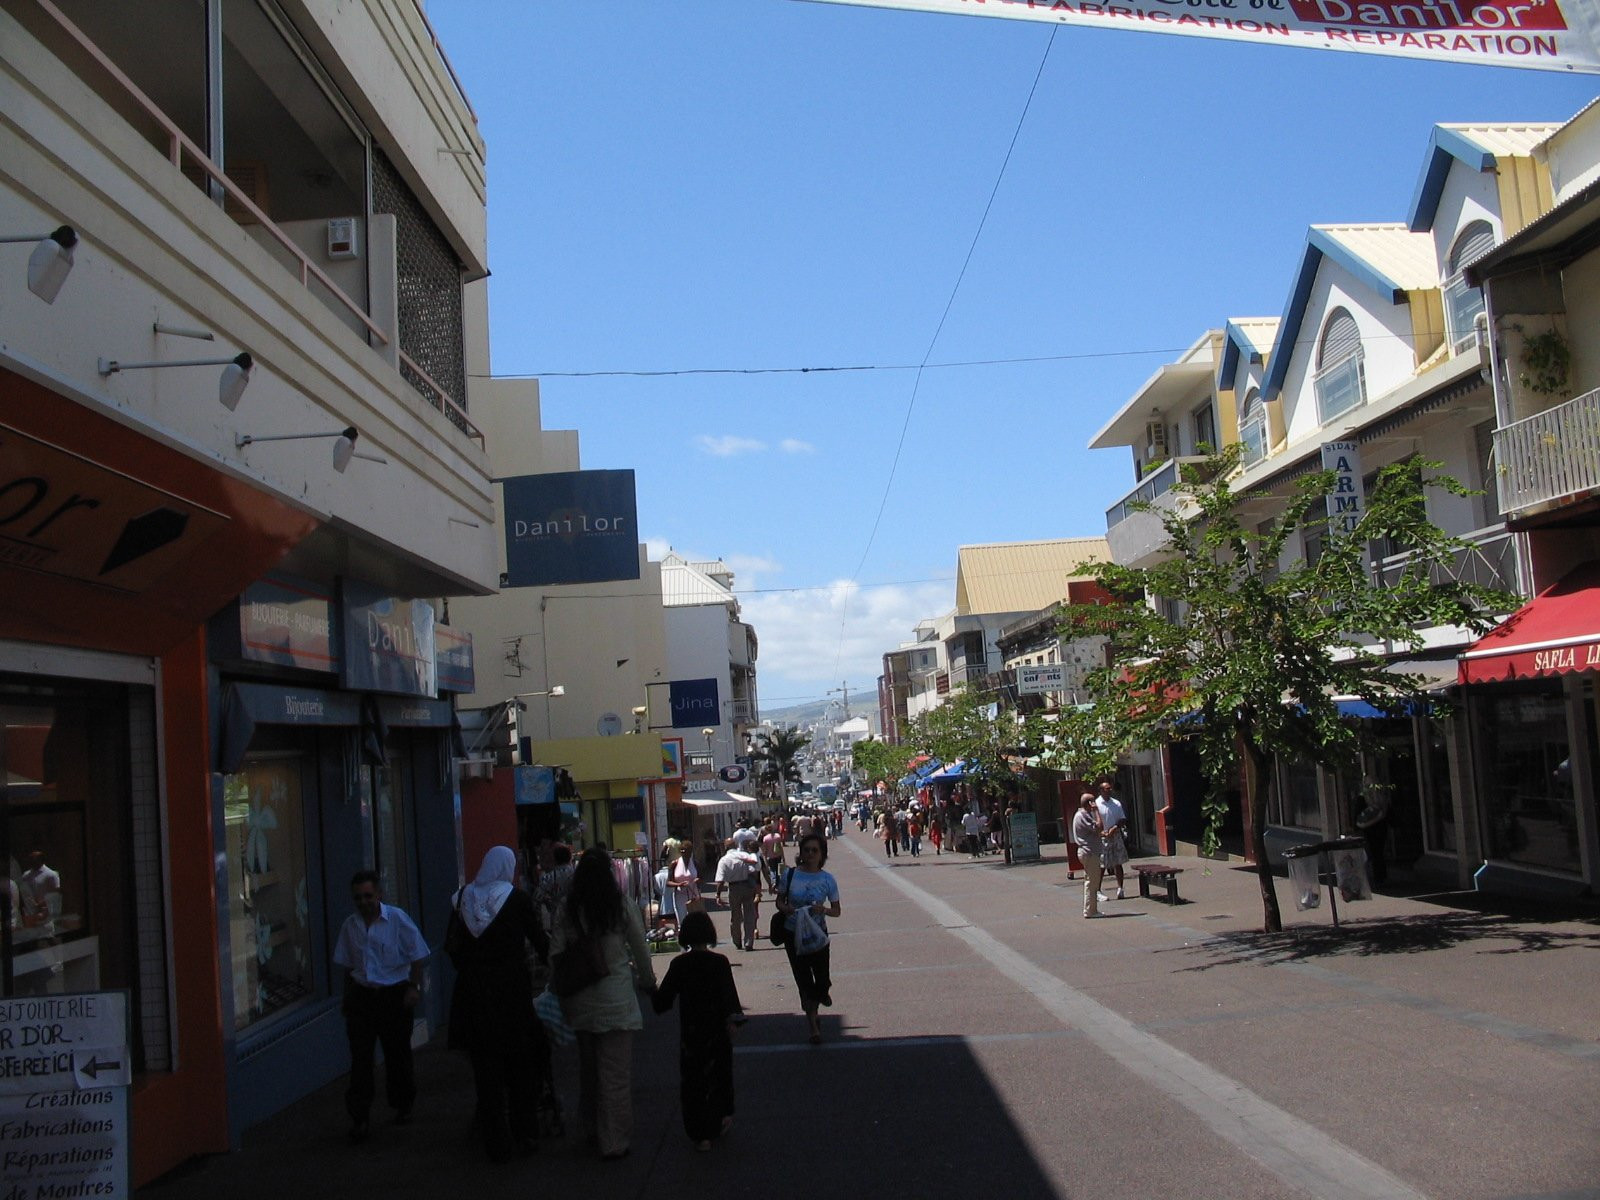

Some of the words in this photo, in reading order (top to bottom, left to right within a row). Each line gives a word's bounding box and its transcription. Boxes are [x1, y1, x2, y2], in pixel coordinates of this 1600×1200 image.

[1028, 0, 1289, 36] FABRICATION
[1325, 27, 1558, 56] REPARATION
[1325, 442, 1358, 452] SIDAT
[515, 515, 624, 537] Danilor
[1534, 648, 1575, 671] SAFLA
[285, 695, 325, 720] Bijouterie
[675, 696, 714, 711] Jina
[685, 778, 717, 793] ECLERC
[25, 1090, 114, 1110] Créations
[0, 1119, 114, 1140] Fabrications
[4, 1147, 114, 1173] Réparations
